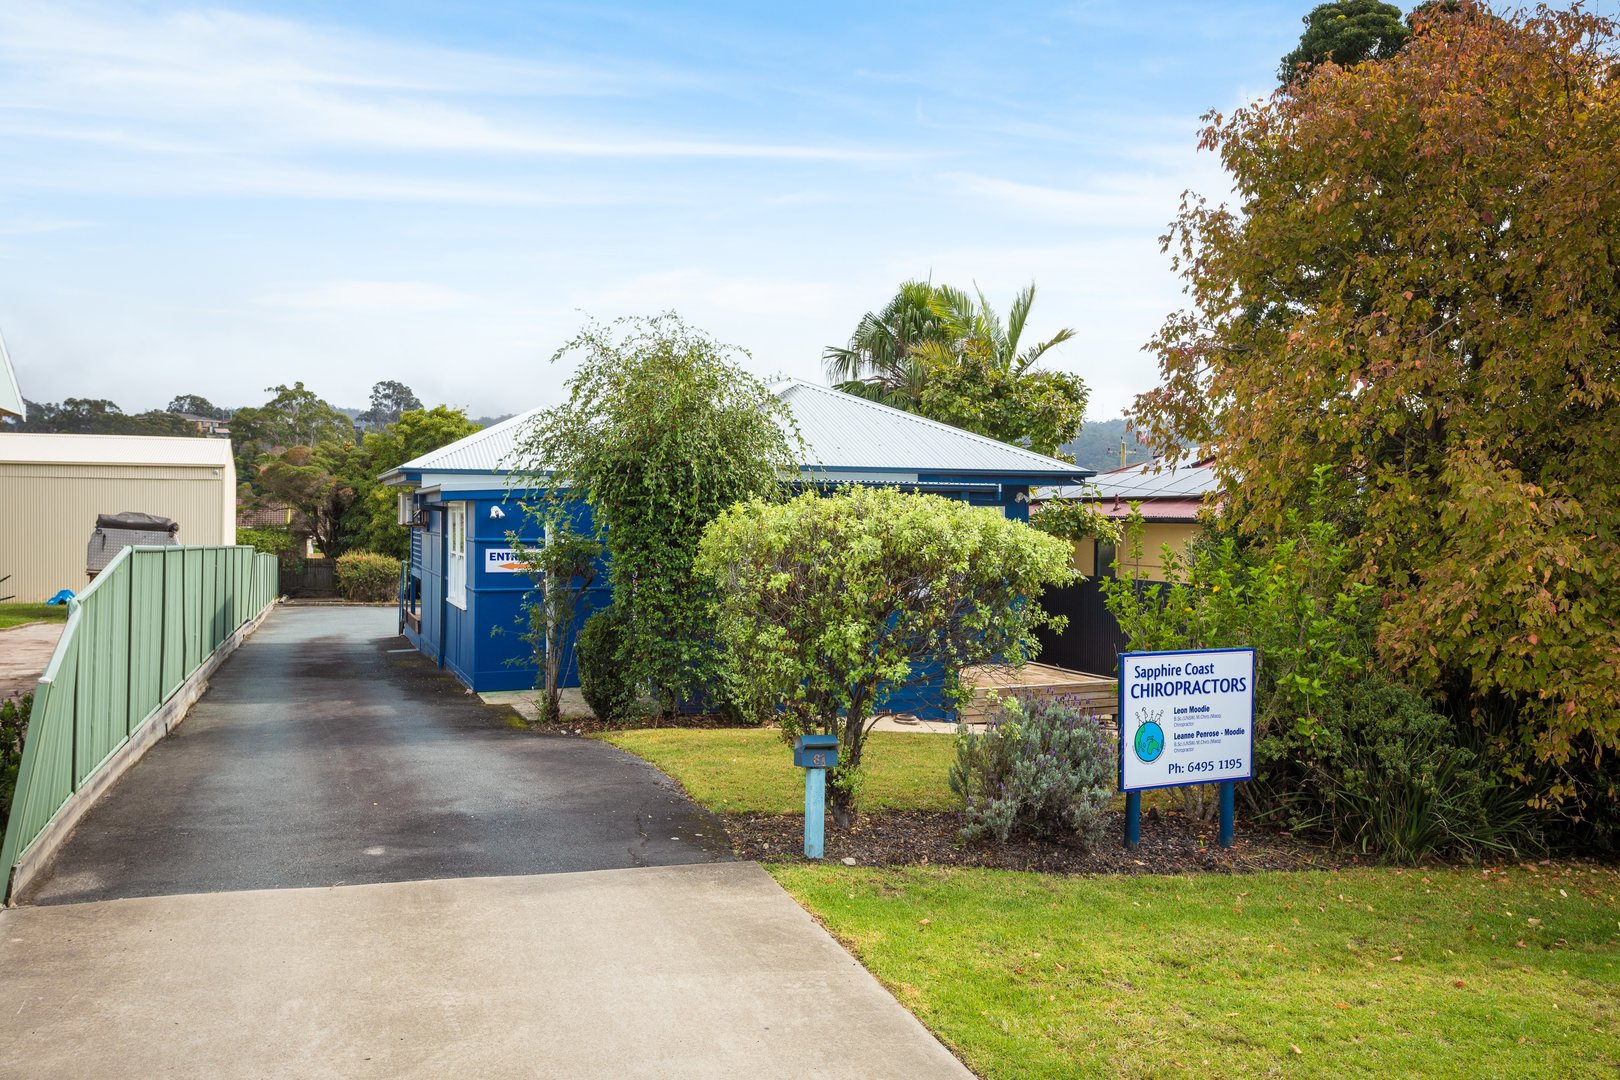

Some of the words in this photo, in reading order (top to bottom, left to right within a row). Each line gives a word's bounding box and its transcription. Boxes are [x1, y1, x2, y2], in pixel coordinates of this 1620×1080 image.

[1134, 664, 1182, 681] Sapphire
[1185, 662, 1215, 676] Coast
[1130, 677, 1247, 699] CHIROPRACTORS
[1173, 706, 1188, 715] Leon
[1189, 704, 1210, 714] Moodie
[1173, 732, 1195, 741] Leanne
[1195, 730, 1220, 739] Penrose
[1224, 727, 1245, 736] Moodie
[1168, 763, 1184, 774] Ph:
[1187, 761, 1214, 773] 6495
[1218, 758, 1242, 770] 1195
